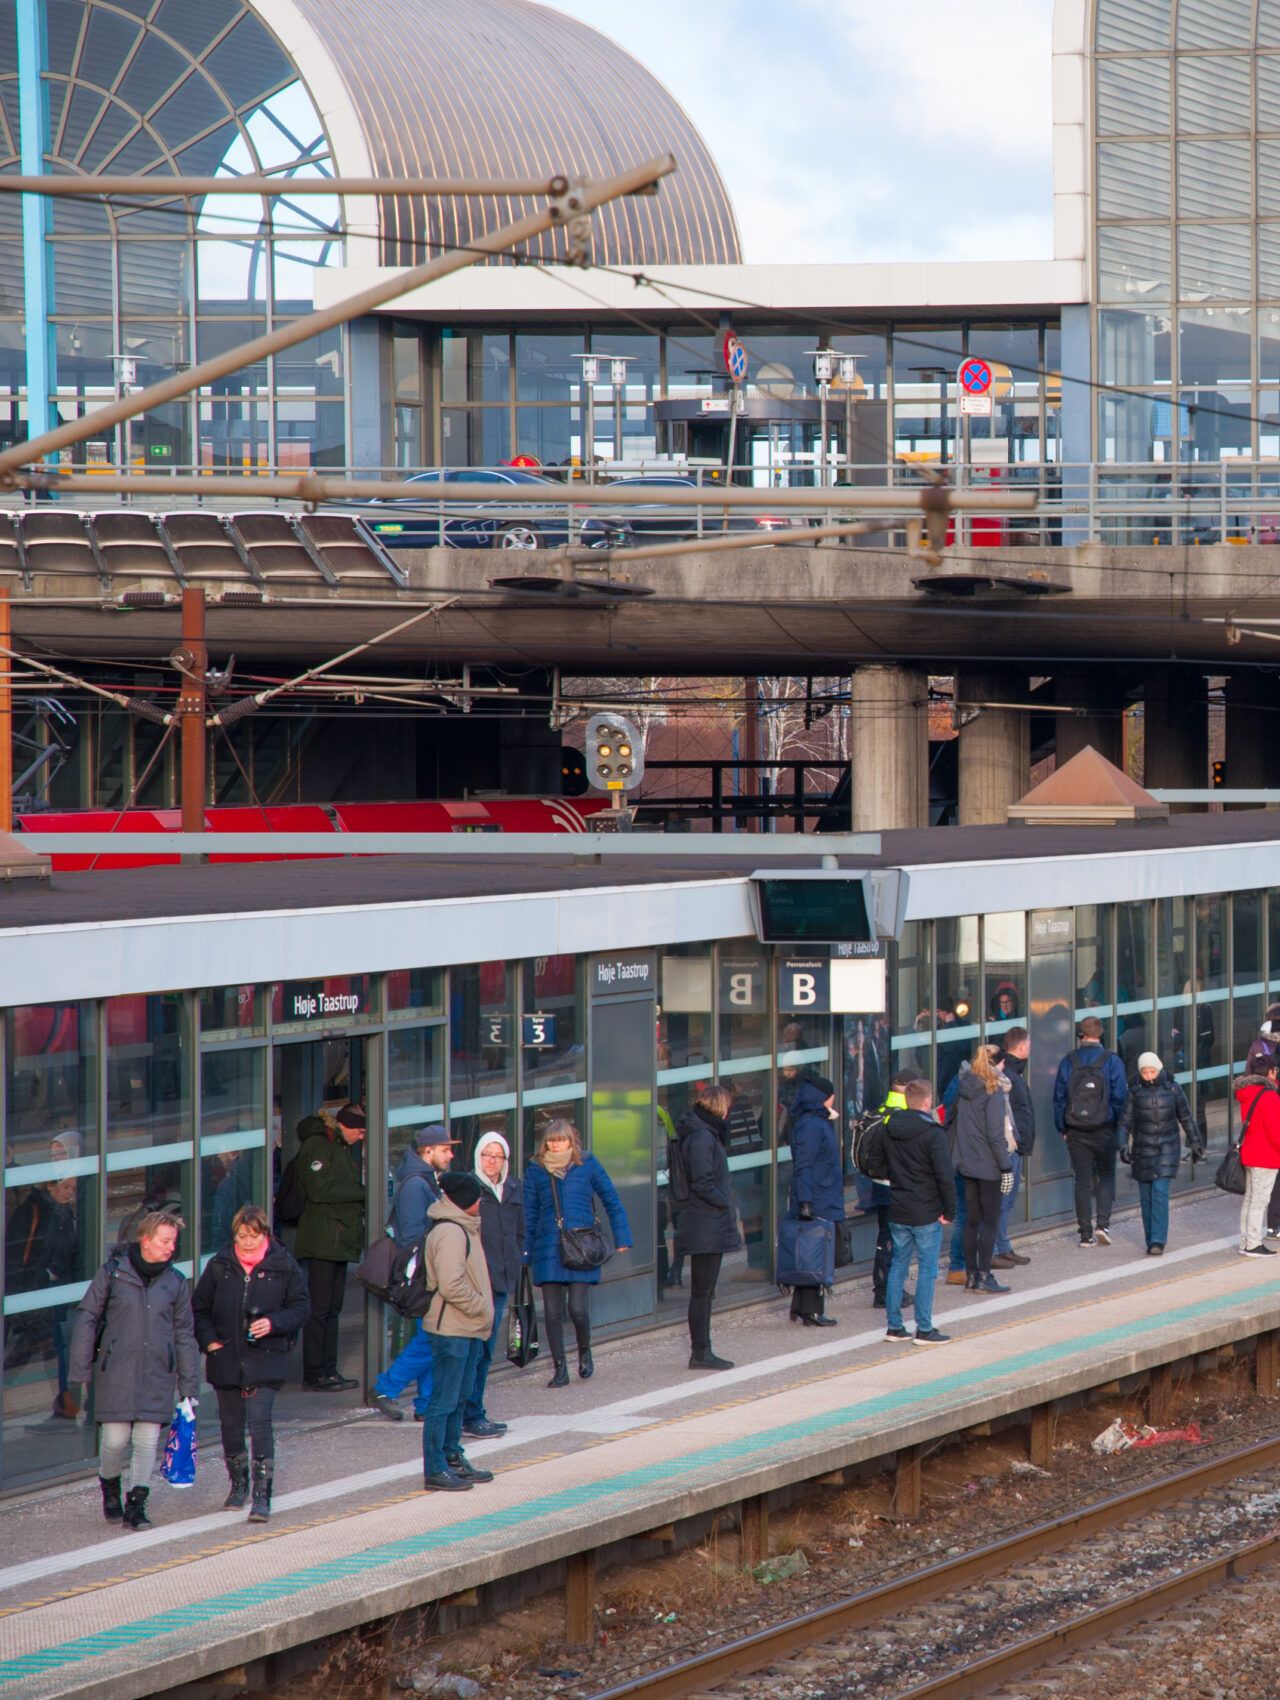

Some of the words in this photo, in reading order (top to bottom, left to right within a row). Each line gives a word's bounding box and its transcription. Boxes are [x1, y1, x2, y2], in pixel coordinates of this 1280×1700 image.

[598, 963, 616, 984] Høje
[616, 962, 649, 981] Taastrup
[792, 974, 816, 1006] B
[294, 994, 316, 1018] Høje
[318, 993, 359, 1014] Taastrup
[532, 1025, 546, 1043] 3
